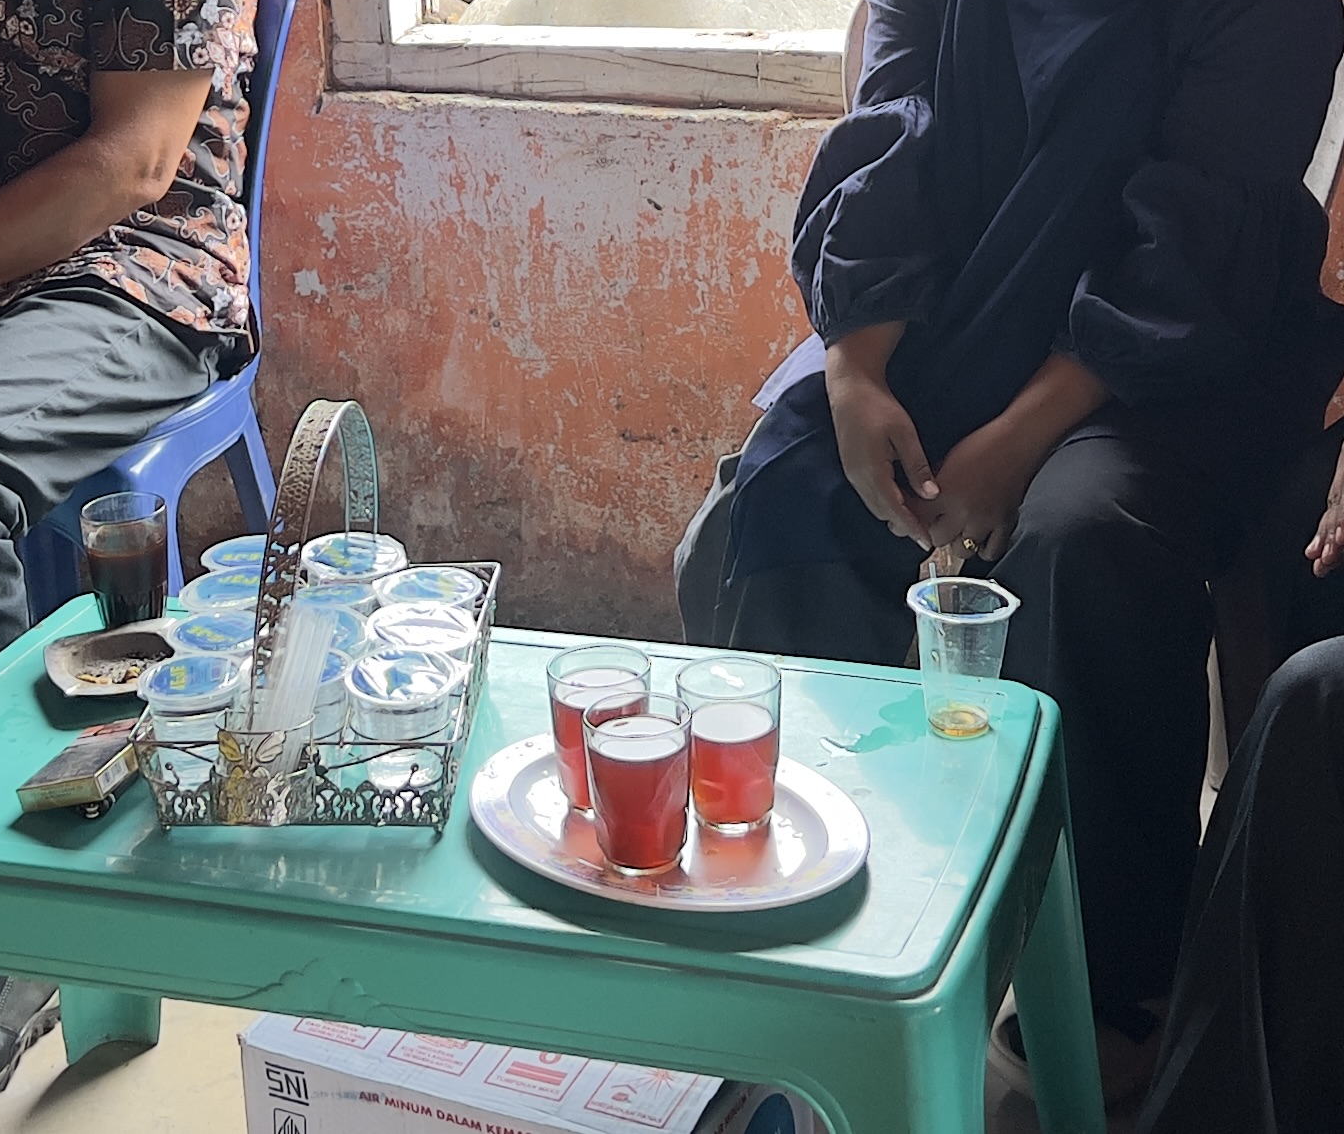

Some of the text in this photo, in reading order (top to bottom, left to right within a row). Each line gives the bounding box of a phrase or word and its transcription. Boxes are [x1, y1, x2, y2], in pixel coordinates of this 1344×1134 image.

[266, 1067, 309, 1100] SNI
[359, 1091, 482, 1132] AIR MINUM DALAM
